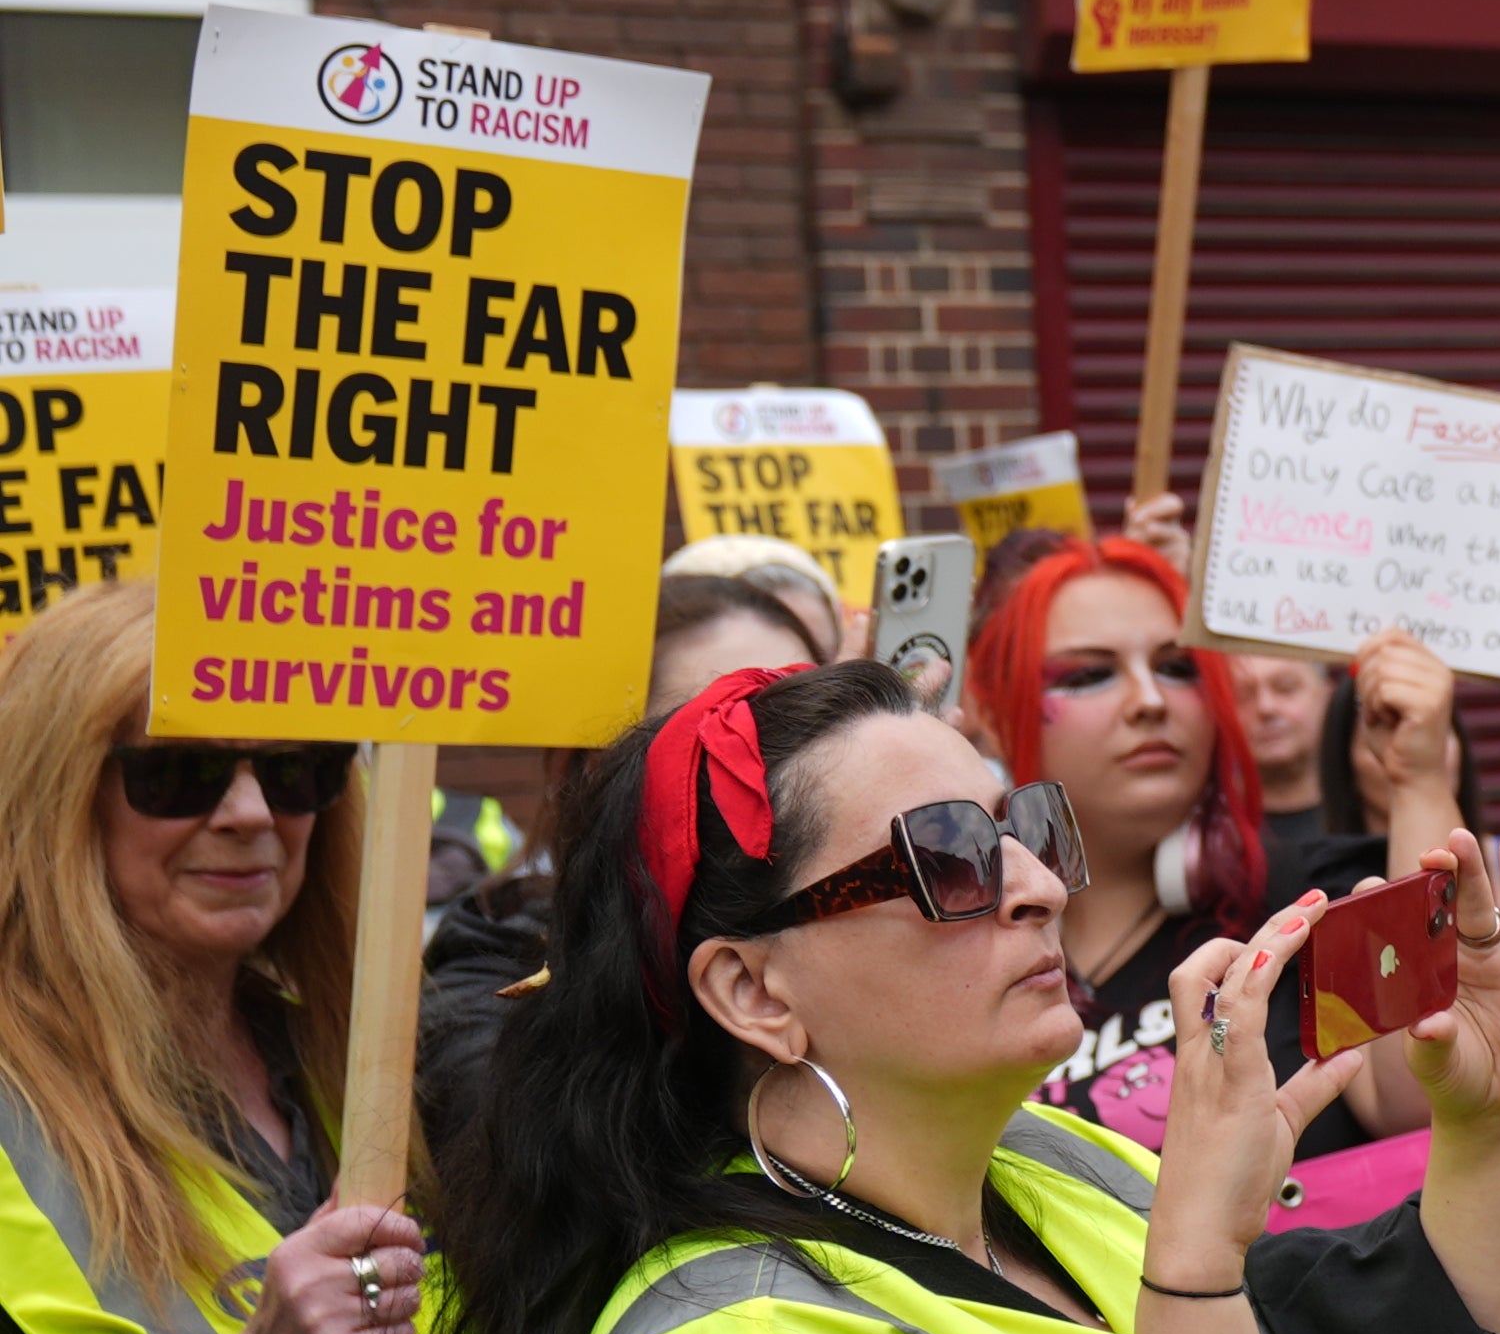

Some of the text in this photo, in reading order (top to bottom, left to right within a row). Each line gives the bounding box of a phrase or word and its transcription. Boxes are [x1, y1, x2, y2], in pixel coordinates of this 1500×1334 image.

[417, 58, 581, 109] STAND UP
[415, 95, 591, 150] TO RACISM
[229, 143, 512, 259] STOP
[87, 307, 125, 333] UP
[225, 251, 634, 381] THE FAR
[35, 335, 142, 363] RACISM
[213, 361, 537, 475] RIGHT
[1256, 376, 1338, 445] Why
[1348, 389, 1391, 434] do
[59, 462, 165, 533] FA
[695, 452, 812, 495] STOP
[202, 478, 568, 560] Justice for
[703, 498, 880, 540] THE FAR
[1241, 493, 1374, 545] Women
[1387, 521, 1448, 558] when
[199, 561, 585, 639] victims and
[1296, 556, 1352, 589] use
[191, 647, 512, 713] survivors
